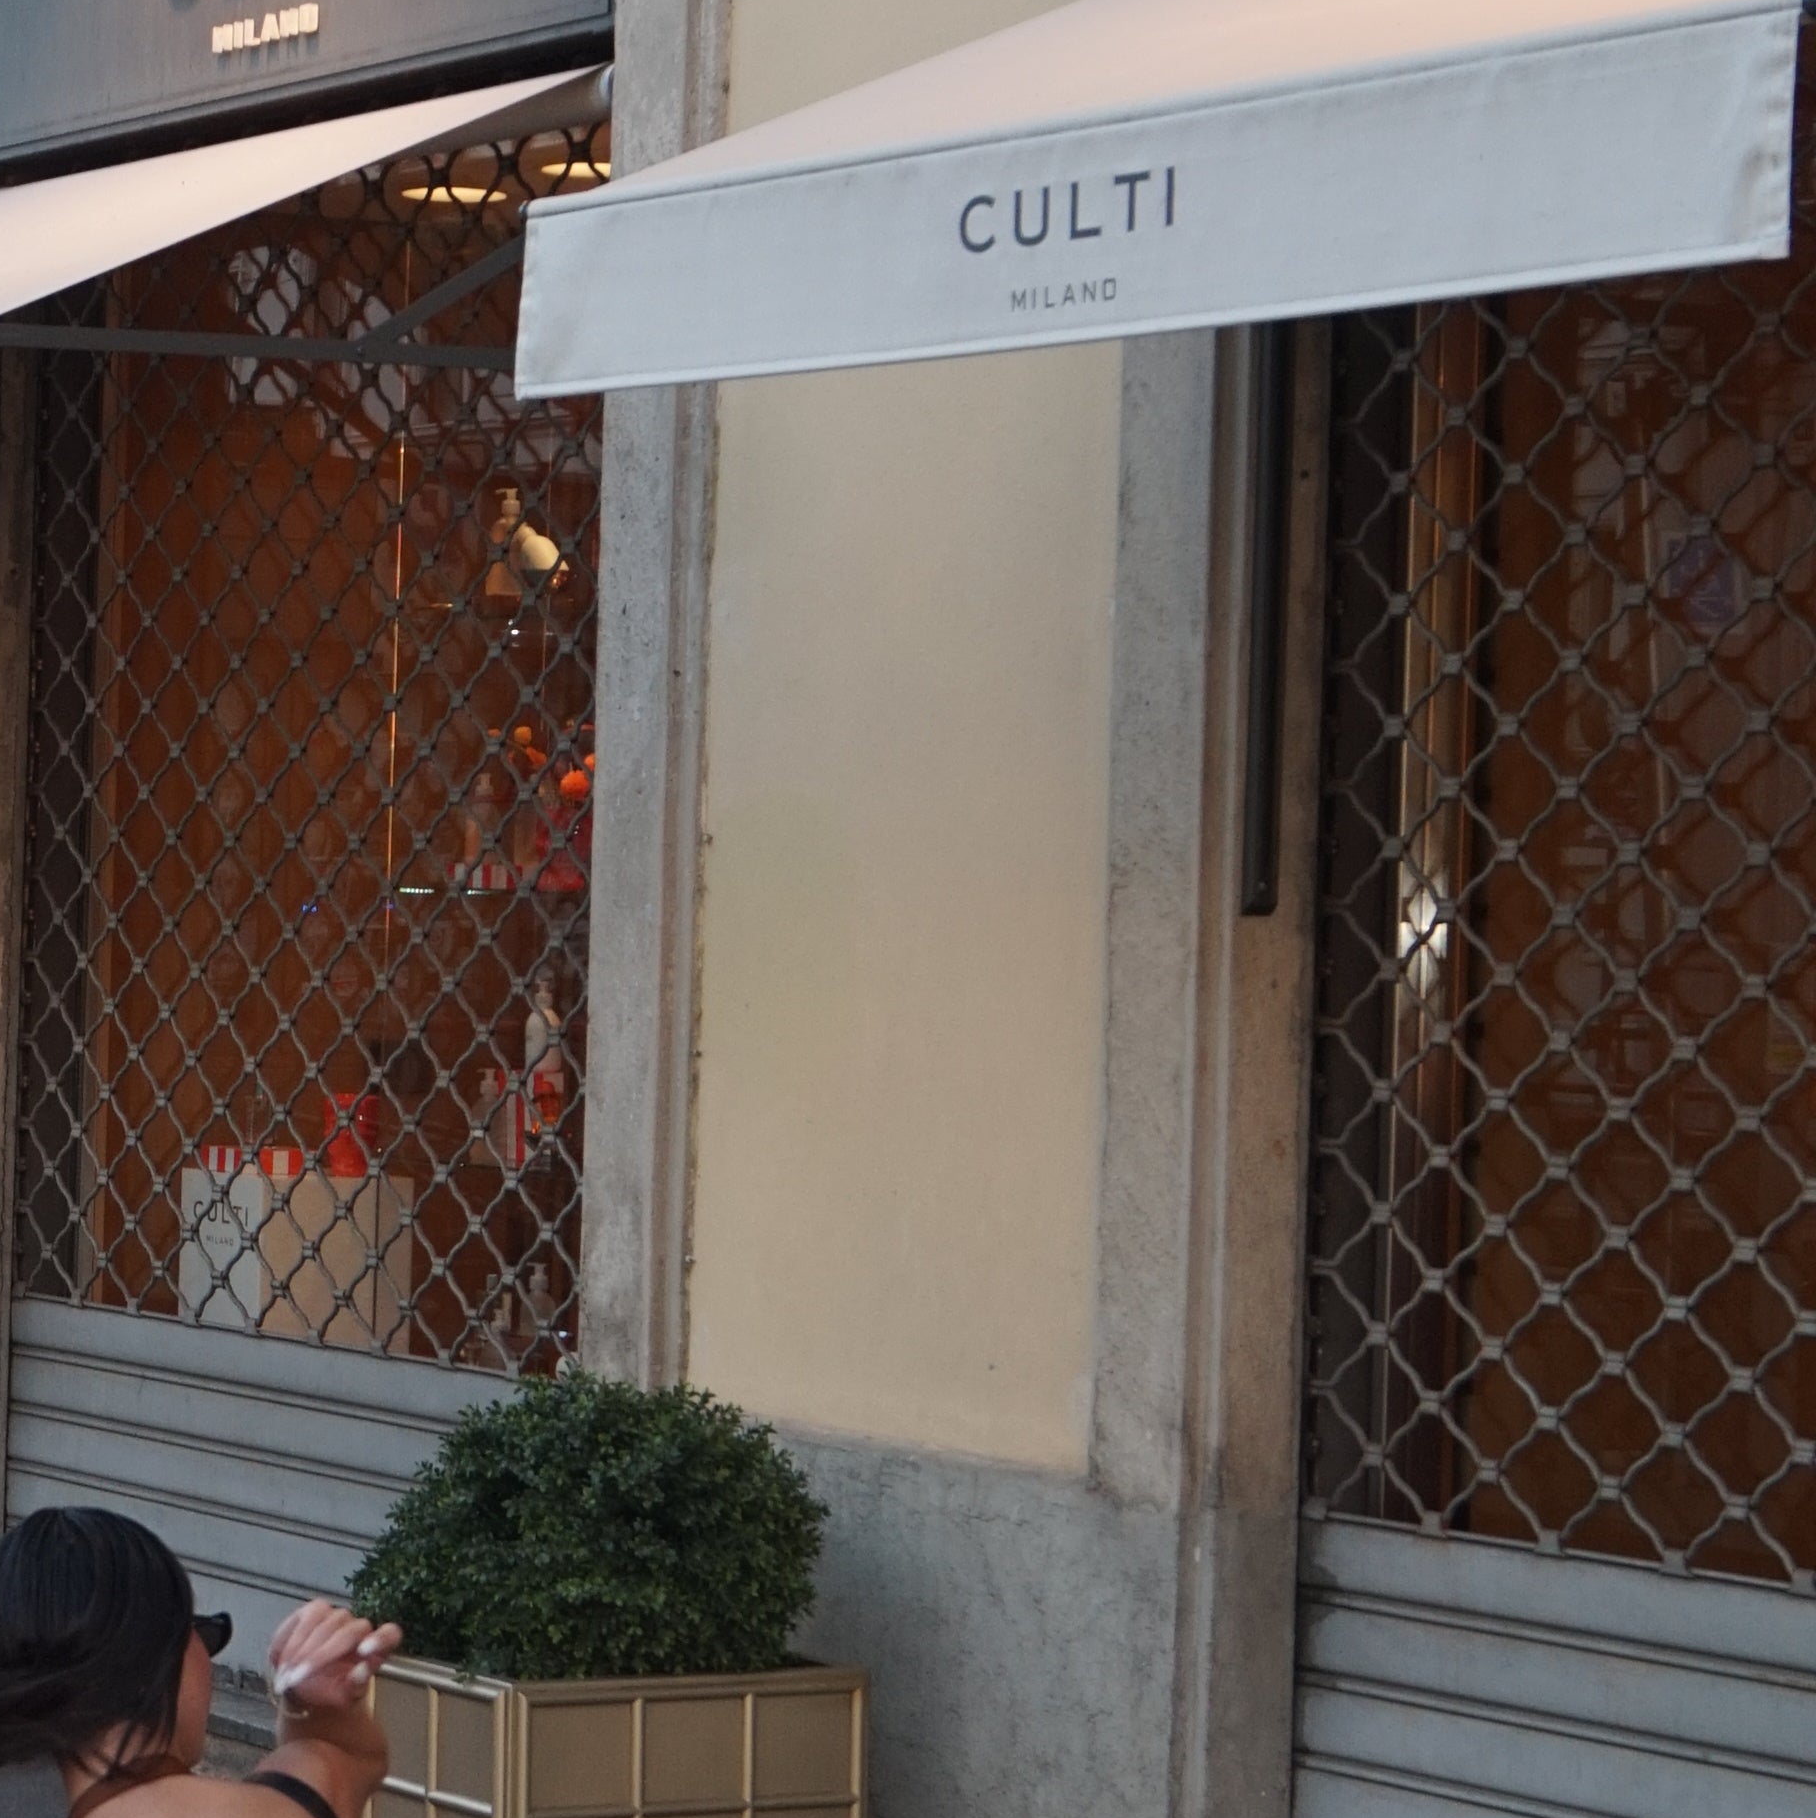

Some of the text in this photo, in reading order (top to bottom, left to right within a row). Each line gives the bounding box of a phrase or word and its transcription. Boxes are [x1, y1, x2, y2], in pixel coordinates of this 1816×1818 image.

[212, 2, 319, 53] MILANO
[959, 165, 1176, 254] CULTI
[1010, 277, 1117, 312] MILANO
